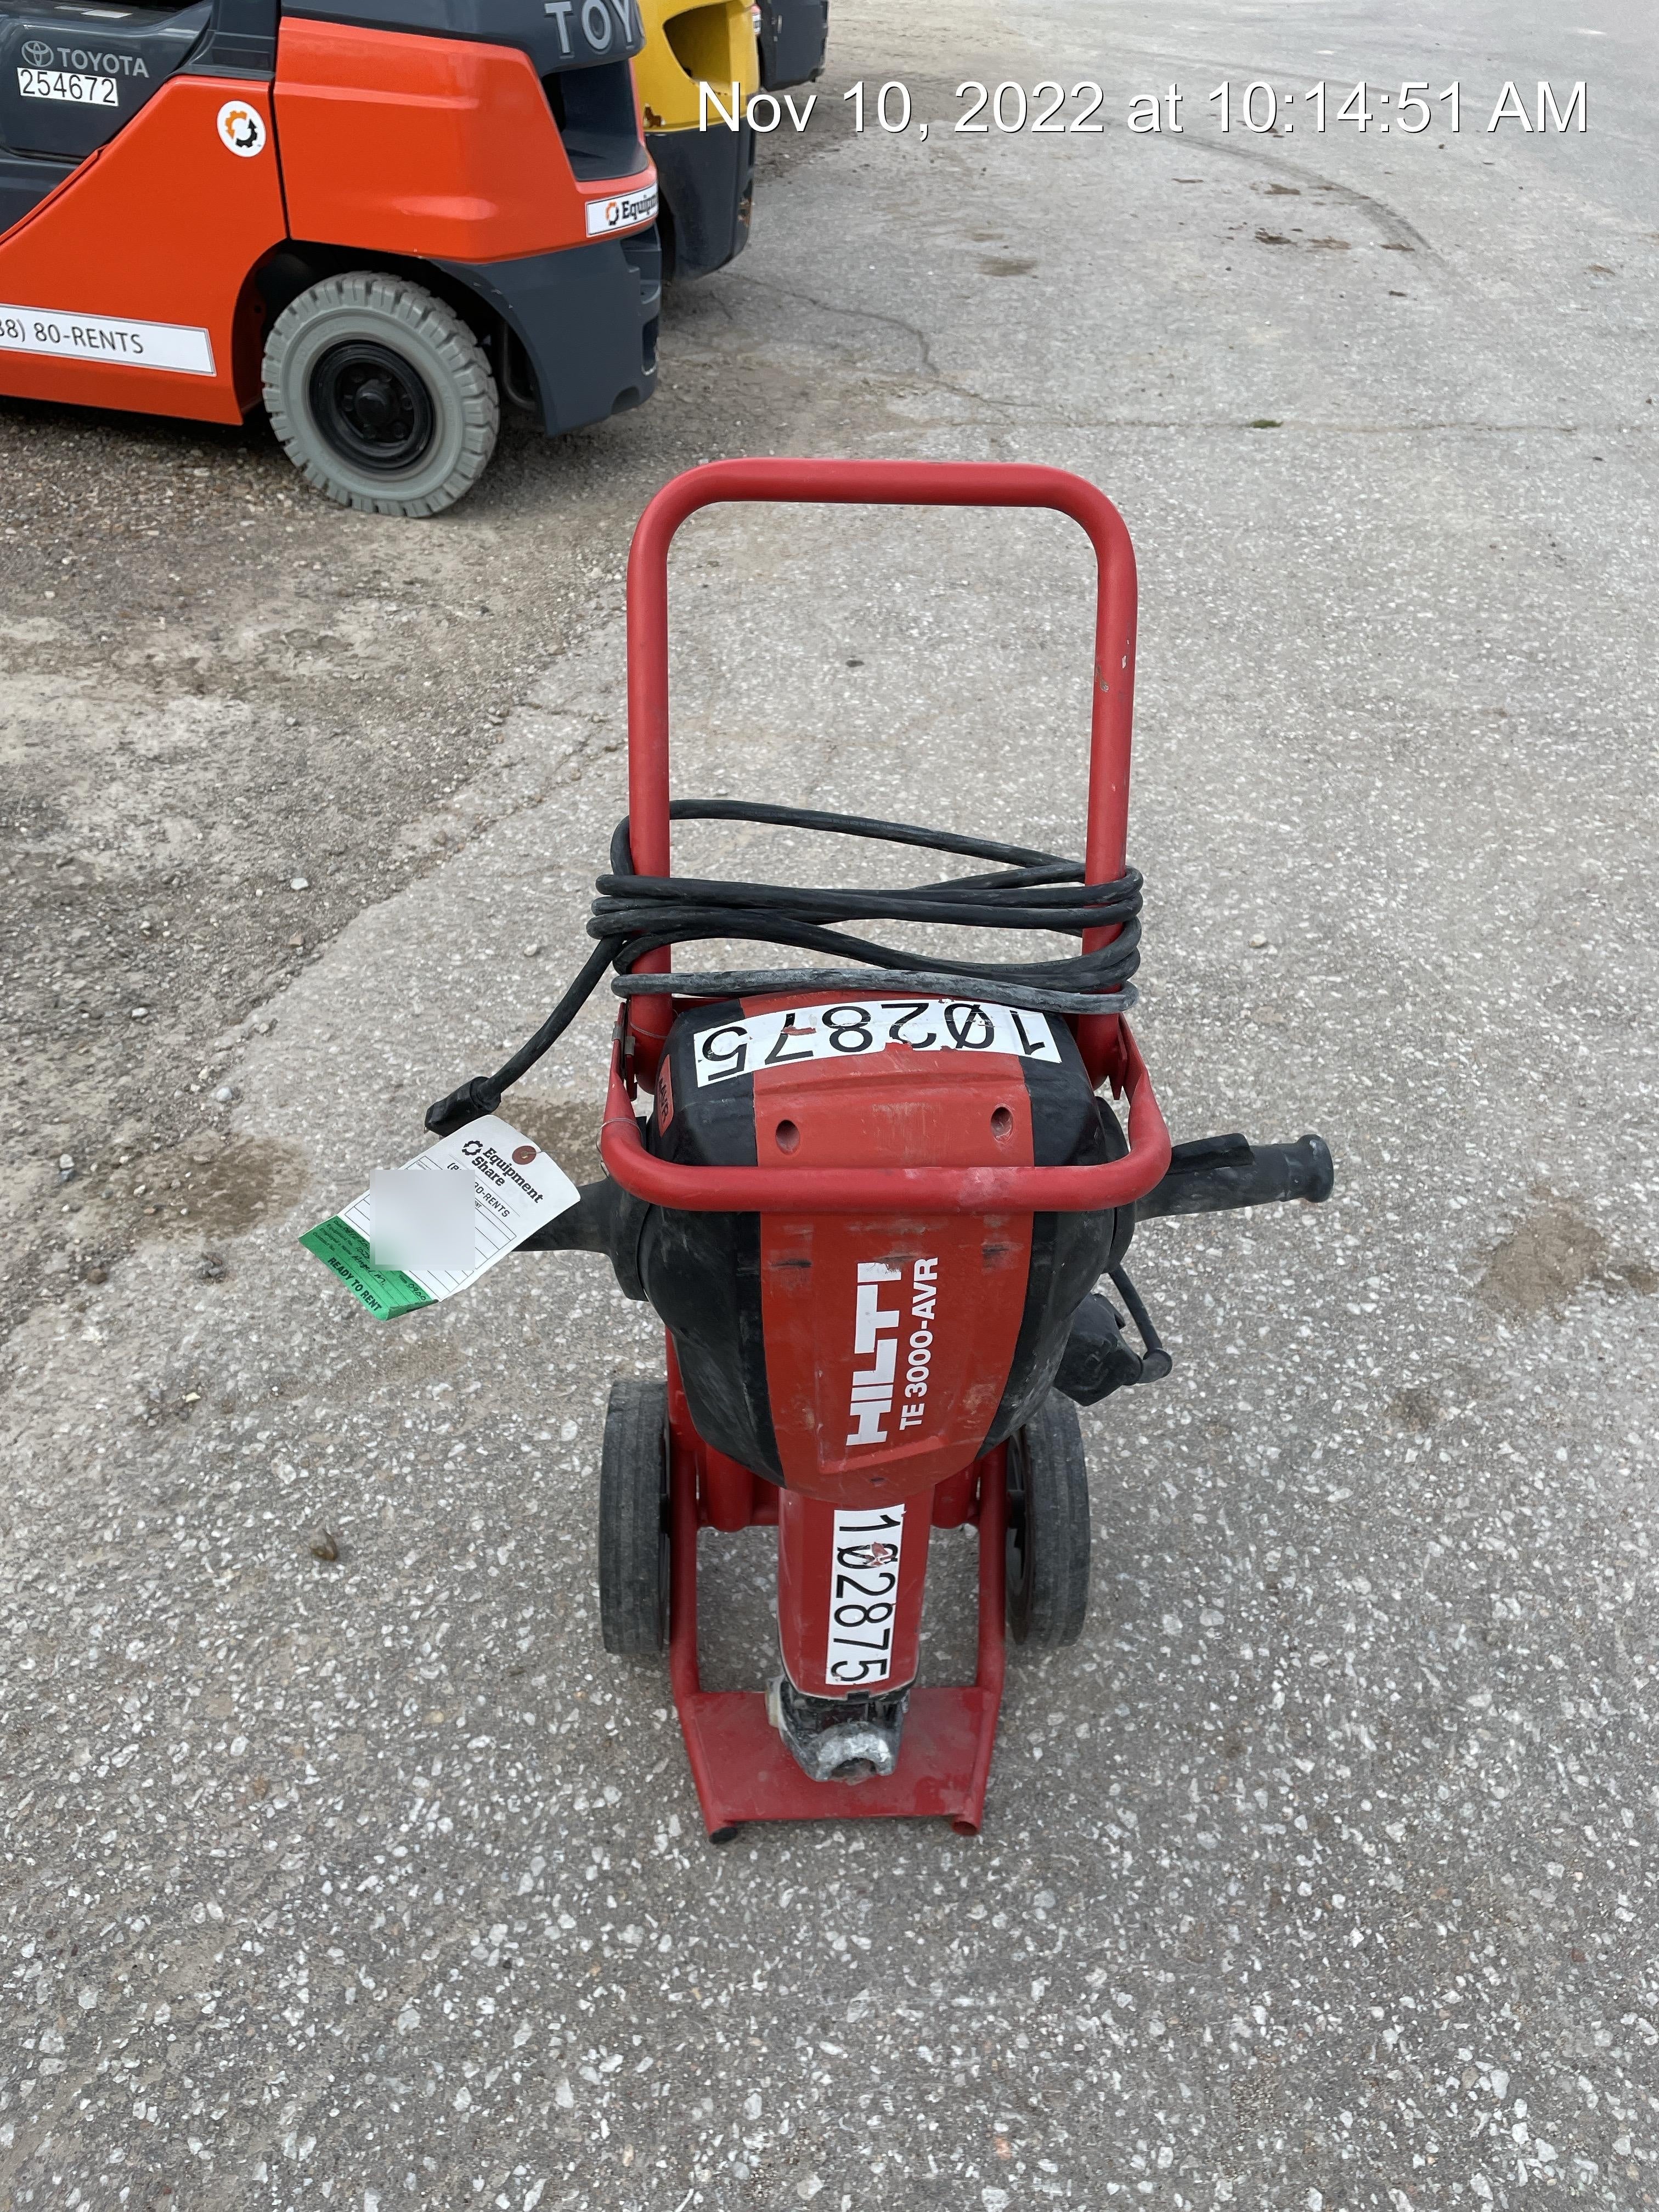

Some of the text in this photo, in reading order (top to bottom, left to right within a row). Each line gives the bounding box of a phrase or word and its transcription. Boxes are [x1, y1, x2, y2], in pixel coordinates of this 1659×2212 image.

[57, 47, 149, 78] TOYOTA
[20, 69, 116, 104] 254672
[33, 322, 144, 354] 80-RENTS
[471, 1156, 505, 1187] Share
[483, 1147, 543, 1204] Equipment
[328, 1256, 382, 1311] READY TO RENT
[846, 1262, 901, 1446] HILTI
[900, 1257, 938, 1431] TE 3000-AVR
